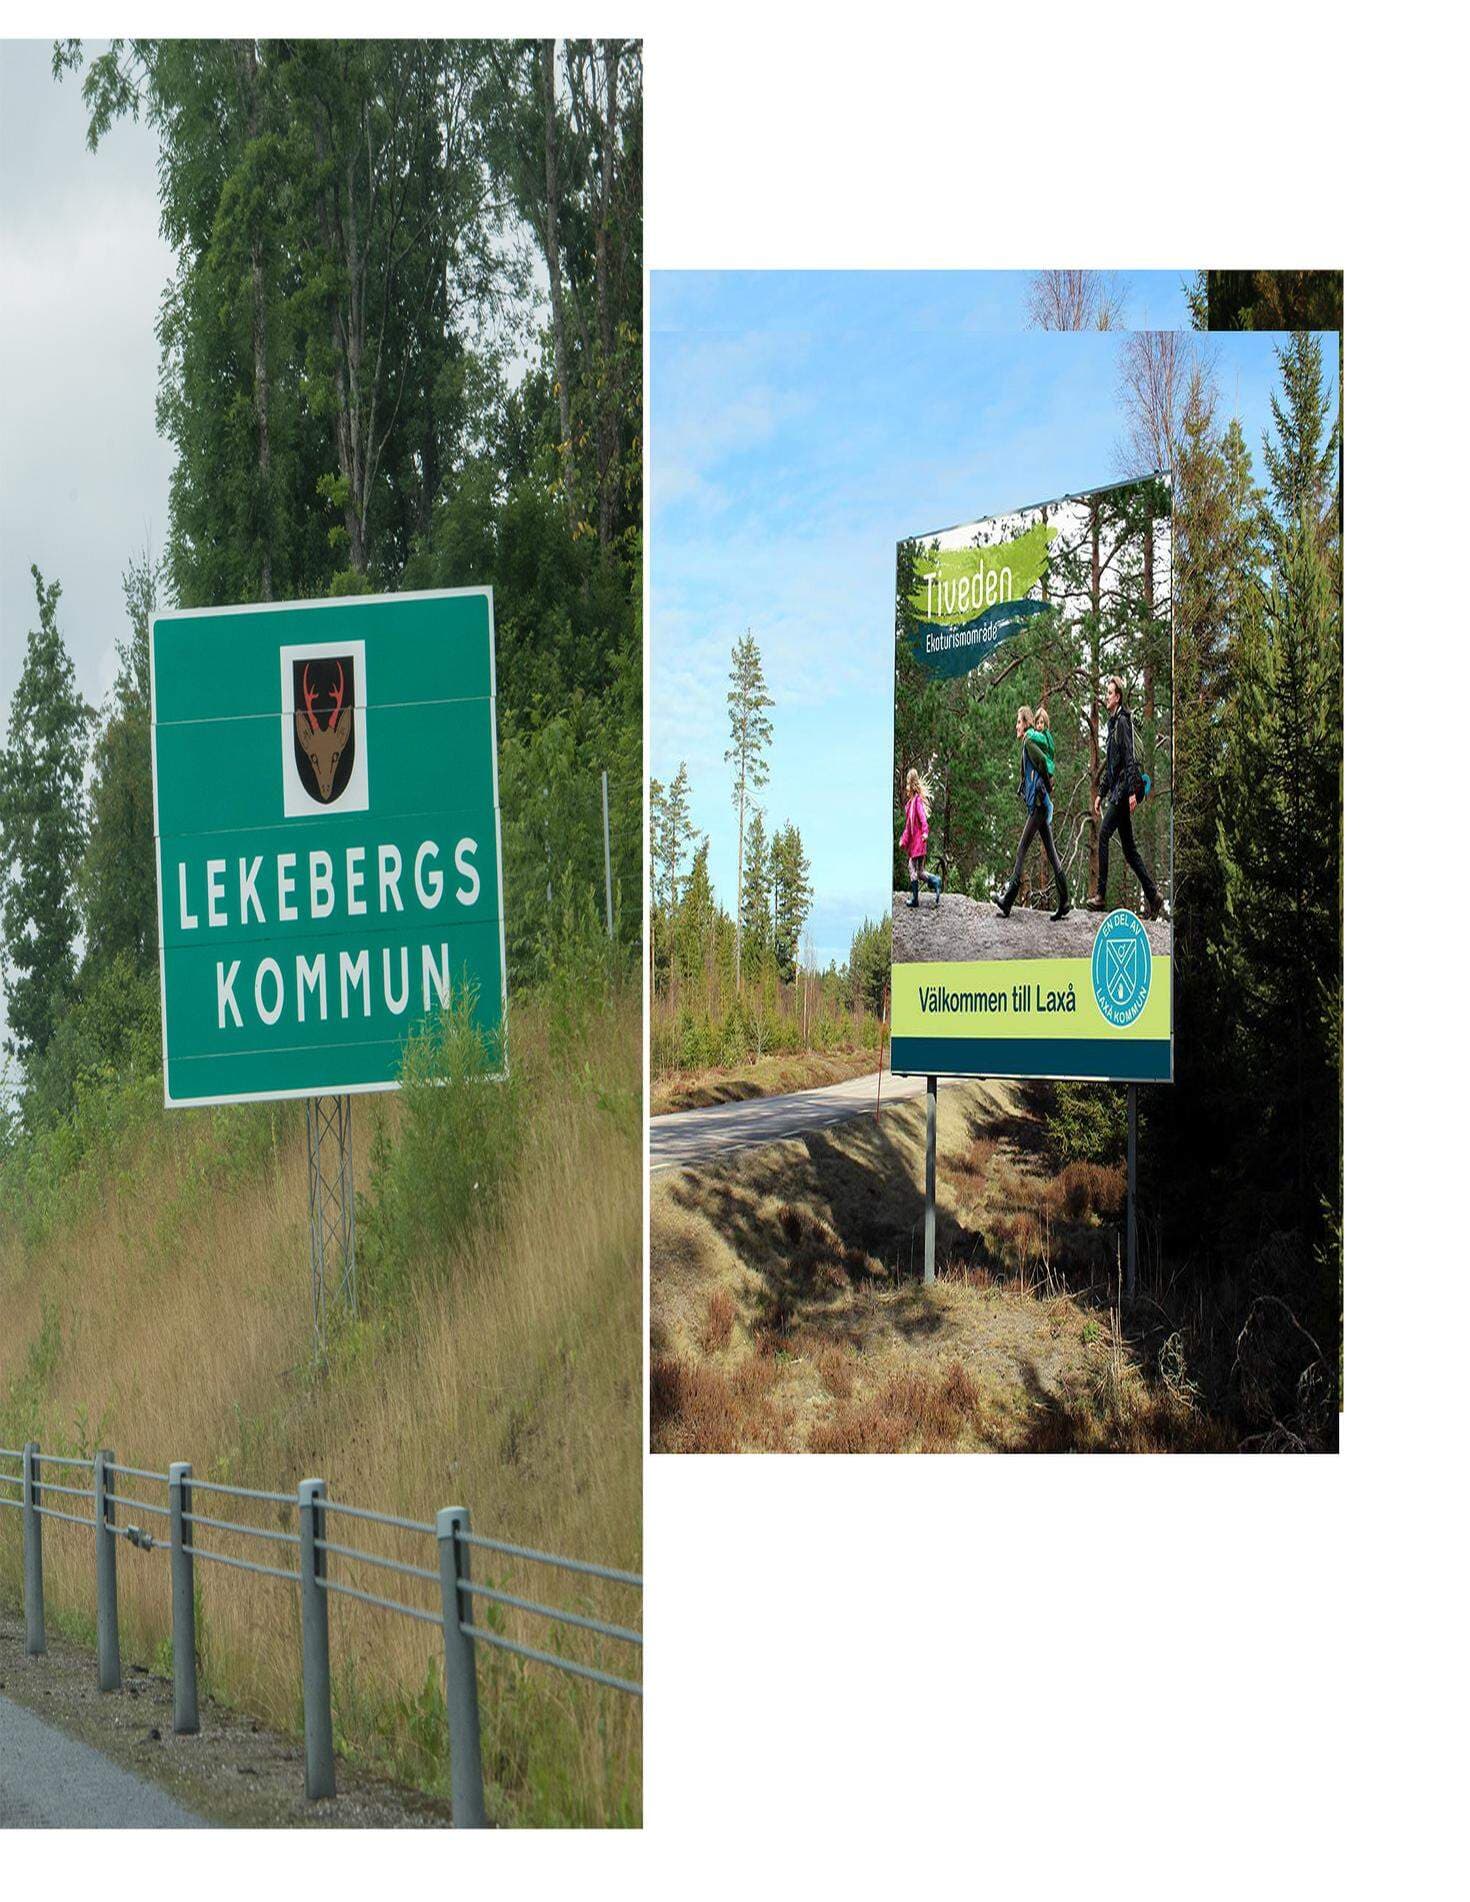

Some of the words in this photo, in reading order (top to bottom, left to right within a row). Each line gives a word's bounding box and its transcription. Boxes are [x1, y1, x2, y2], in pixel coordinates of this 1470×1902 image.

[923, 559, 1013, 619] Tiveden
[926, 622, 998, 653] Ekoturismområde
[179, 837, 481, 930] LEKEBERGS
[1102, 921, 1114, 937] EN
[1114, 913, 1129, 926] DEL
[1129, 921, 1142, 937] AV
[216, 943, 453, 1029] KOMMUN
[919, 986, 1007, 1012] Välkommen
[1012, 985, 1030, 1012] till
[1036, 983, 1076, 1012] Laxå
[1113, 987, 1147, 1023] KOMMUN
